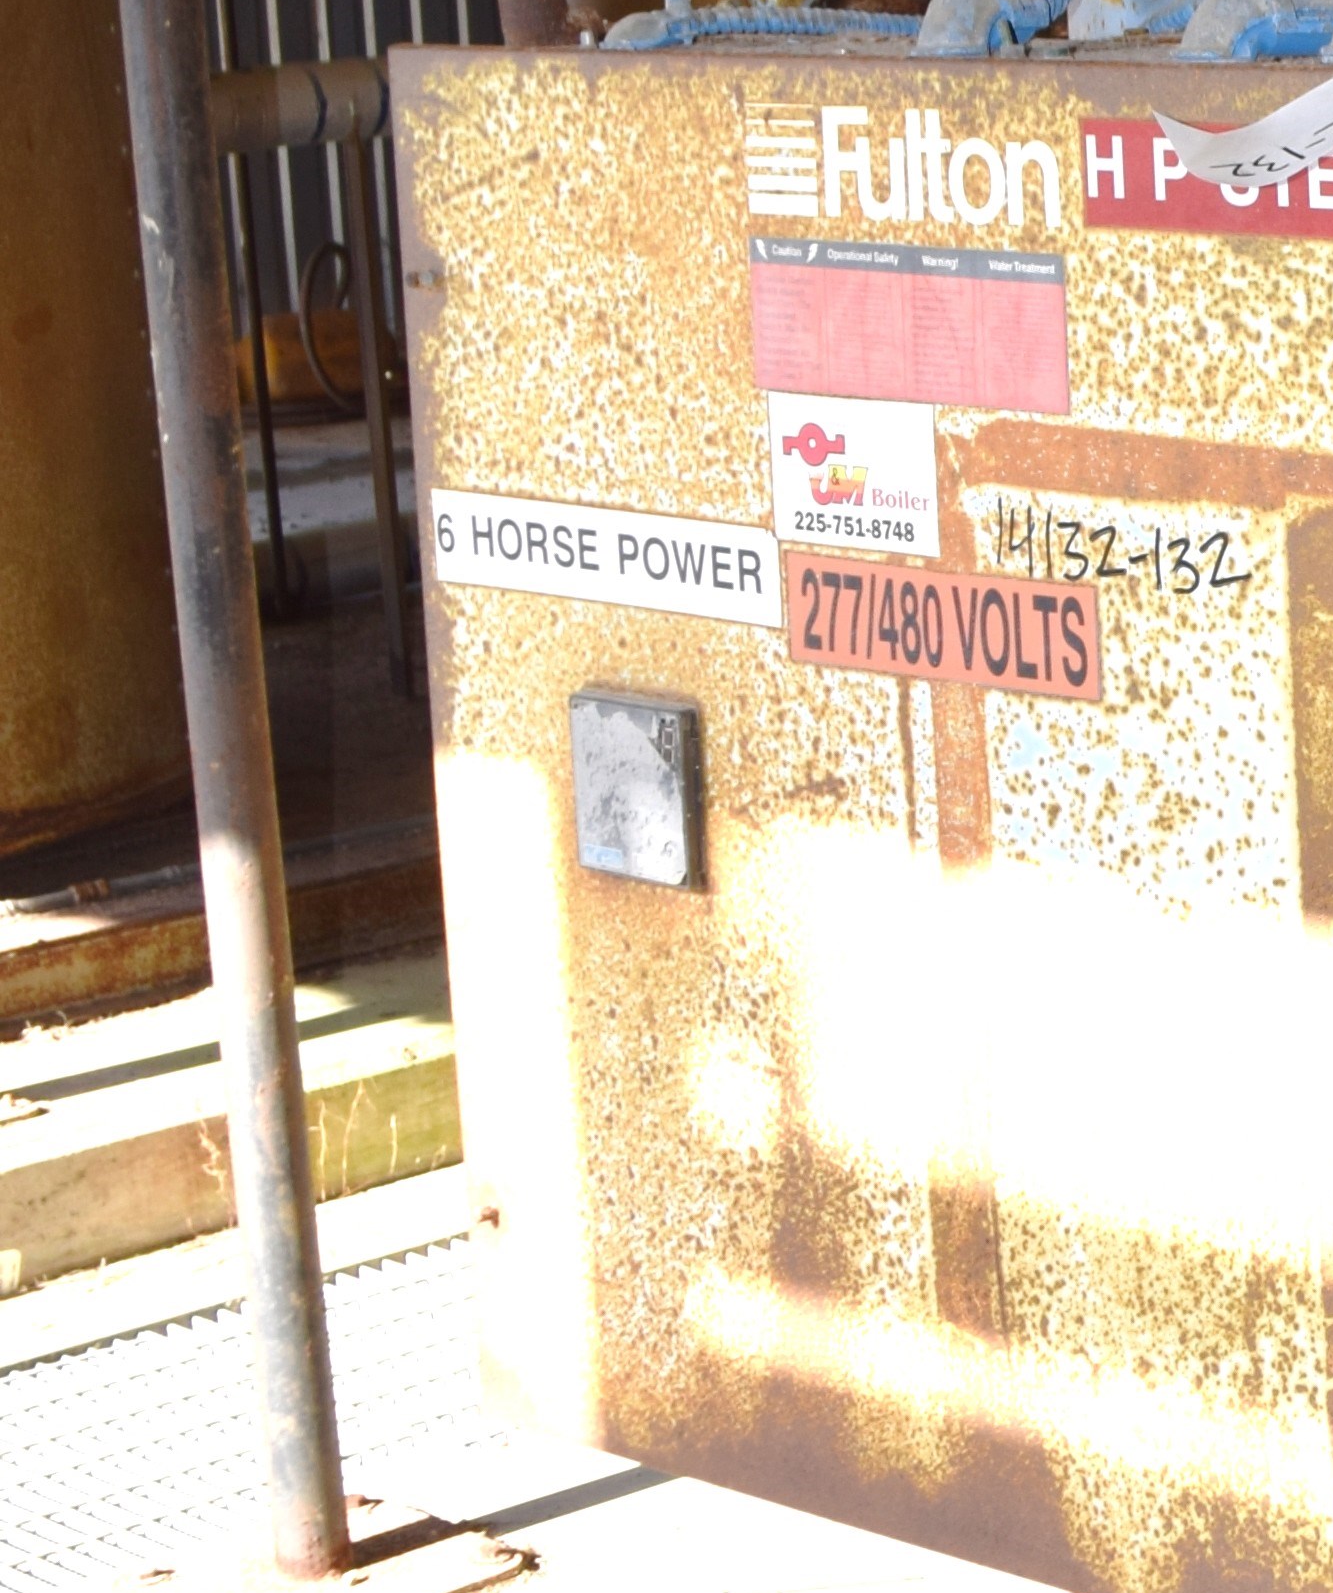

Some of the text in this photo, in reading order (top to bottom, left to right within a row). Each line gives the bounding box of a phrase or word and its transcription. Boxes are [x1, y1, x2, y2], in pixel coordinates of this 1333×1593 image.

[820, 105, 1062, 228] Fulton
[1085, 134, 1125, 200] H
[1152, 137, 1189, 202] P
[771, 244, 803, 258] Caution
[827, 248, 899, 266] Operational Safety
[921, 255, 960, 271] Warning!
[988, 259, 1056, 275] Water Treatment
[872, 487, 931, 512] Boiler
[794, 510, 916, 543] 225-751-8748
[436, 513, 763, 595] 6 HORSE POWER
[996, 497, 1252, 595] 14132-132
[800, 566, 1089, 688] 277/480 VOLTS
